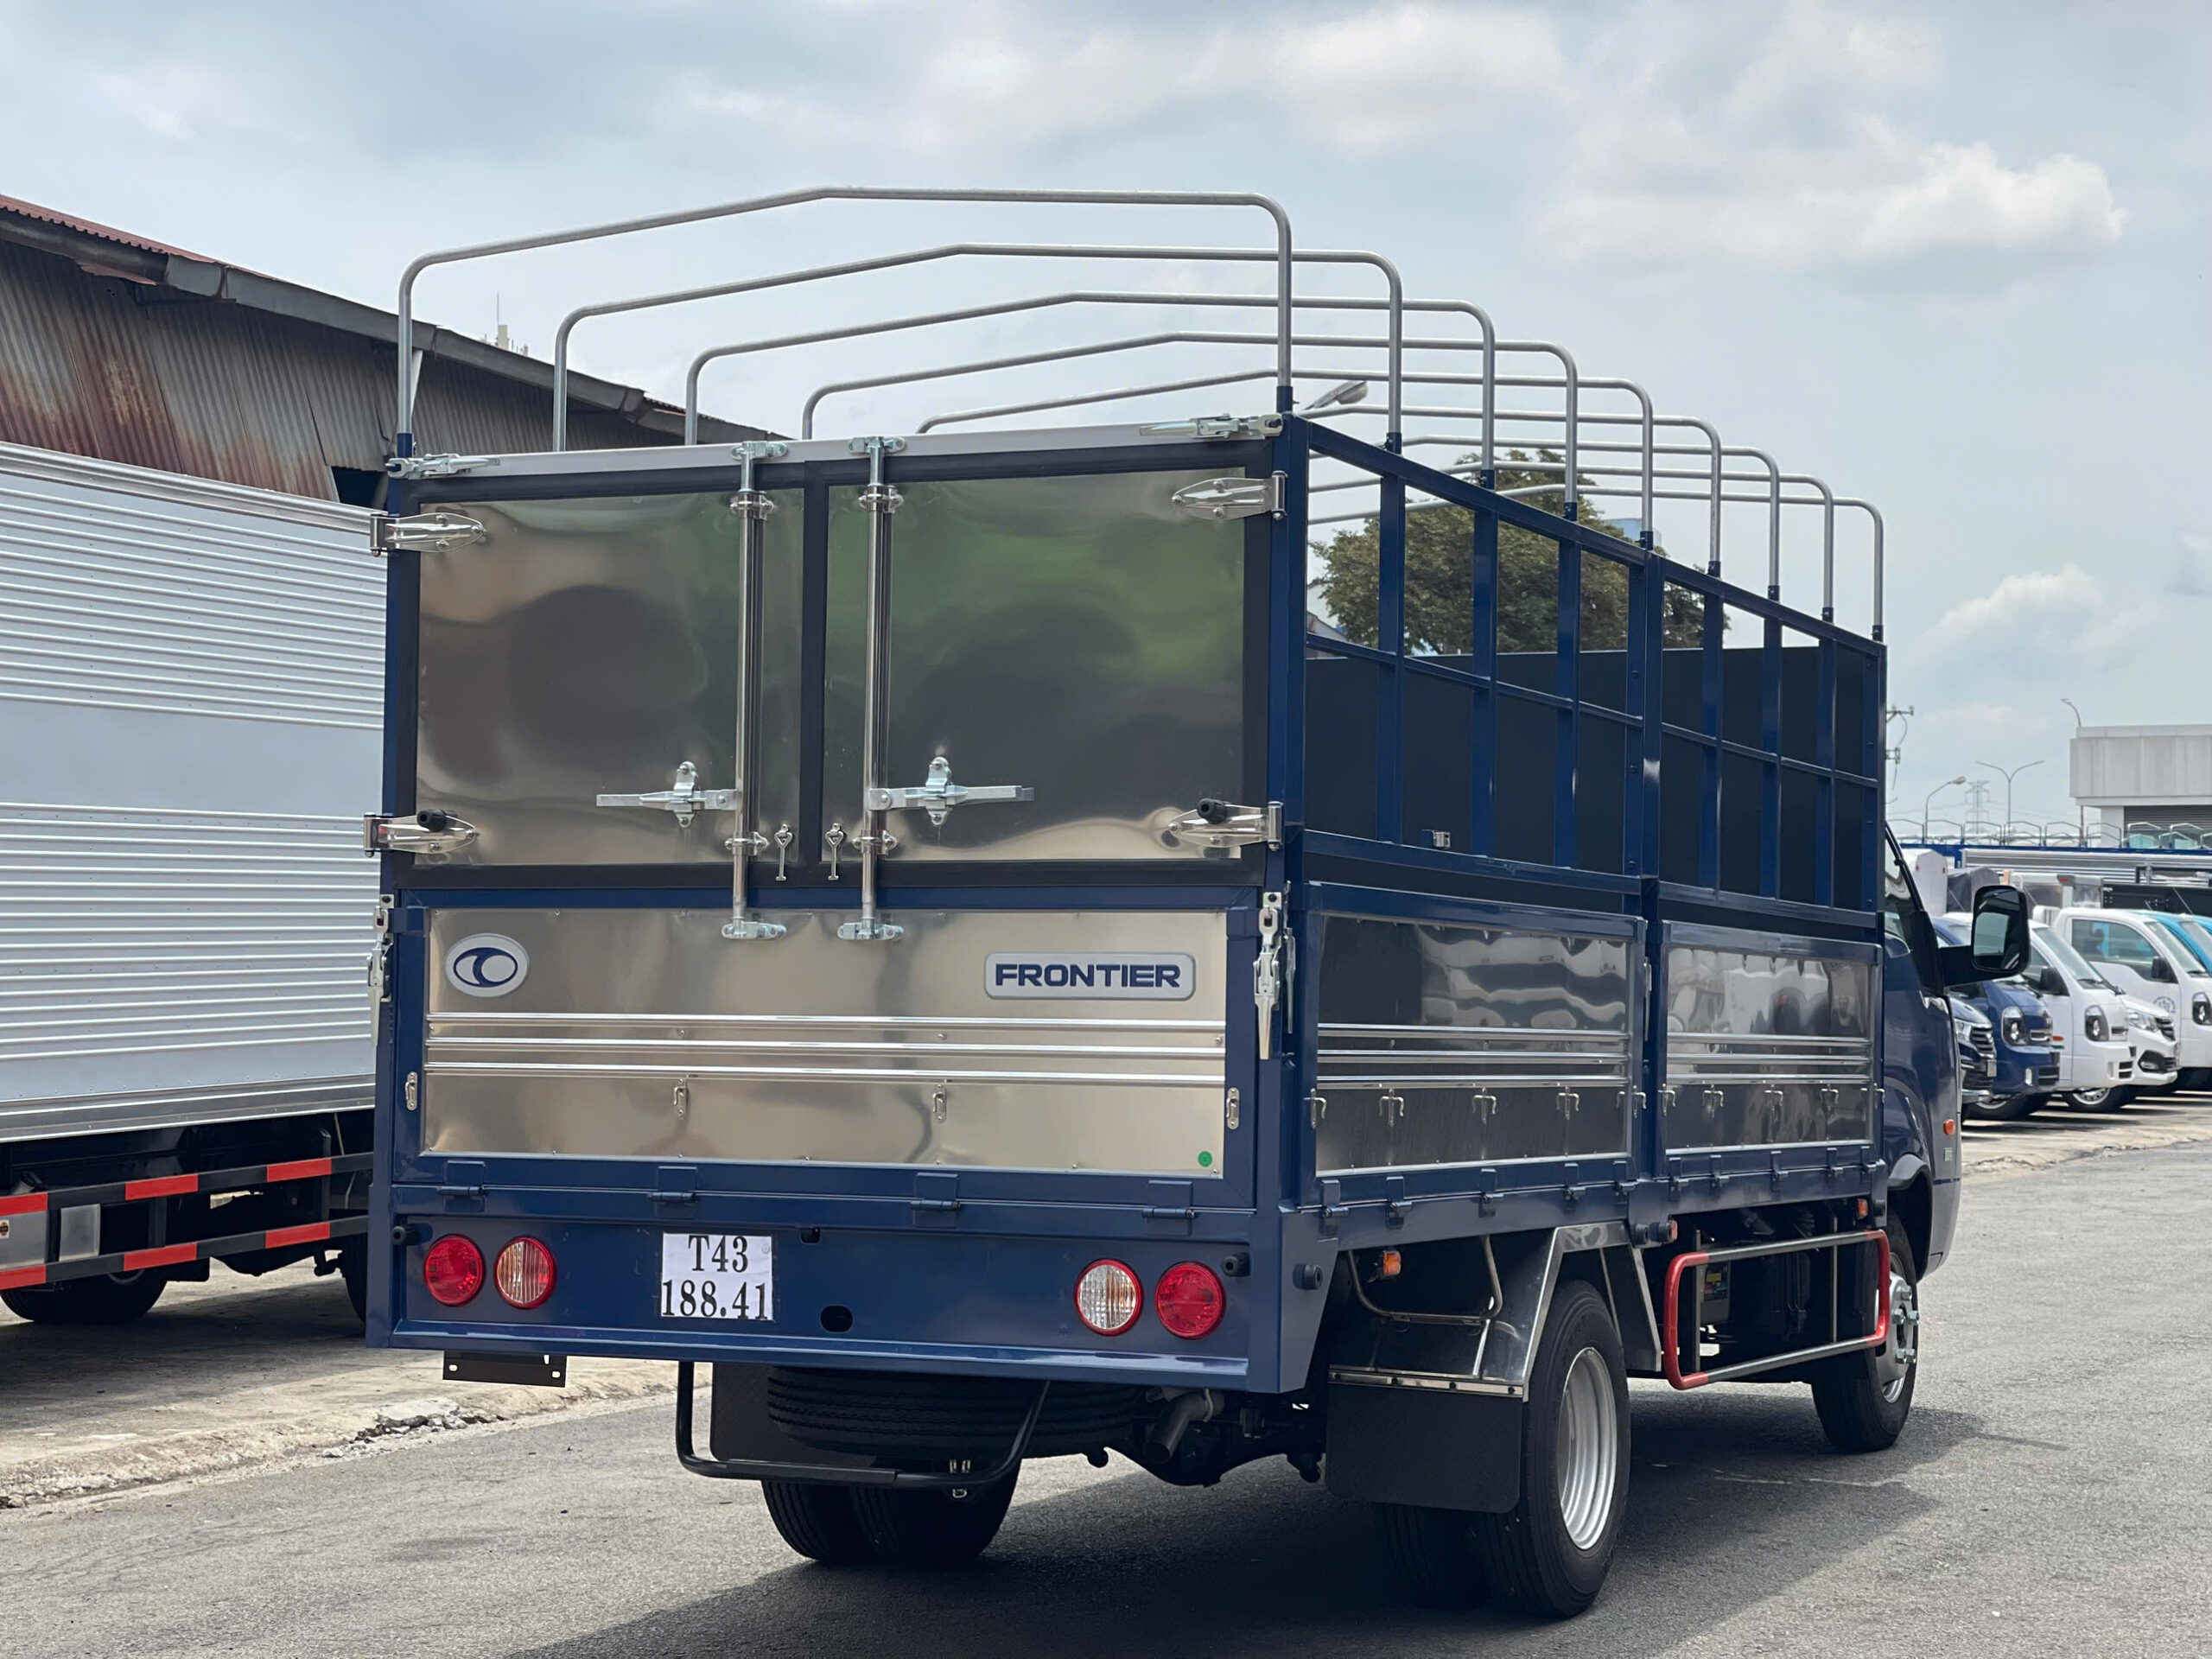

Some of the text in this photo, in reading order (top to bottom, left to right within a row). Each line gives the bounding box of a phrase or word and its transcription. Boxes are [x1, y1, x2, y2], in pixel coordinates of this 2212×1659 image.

[995, 963, 1181, 988] FRONTIER
[688, 1235, 749, 1274] T43
[662, 1279, 768, 1319] 188.41
